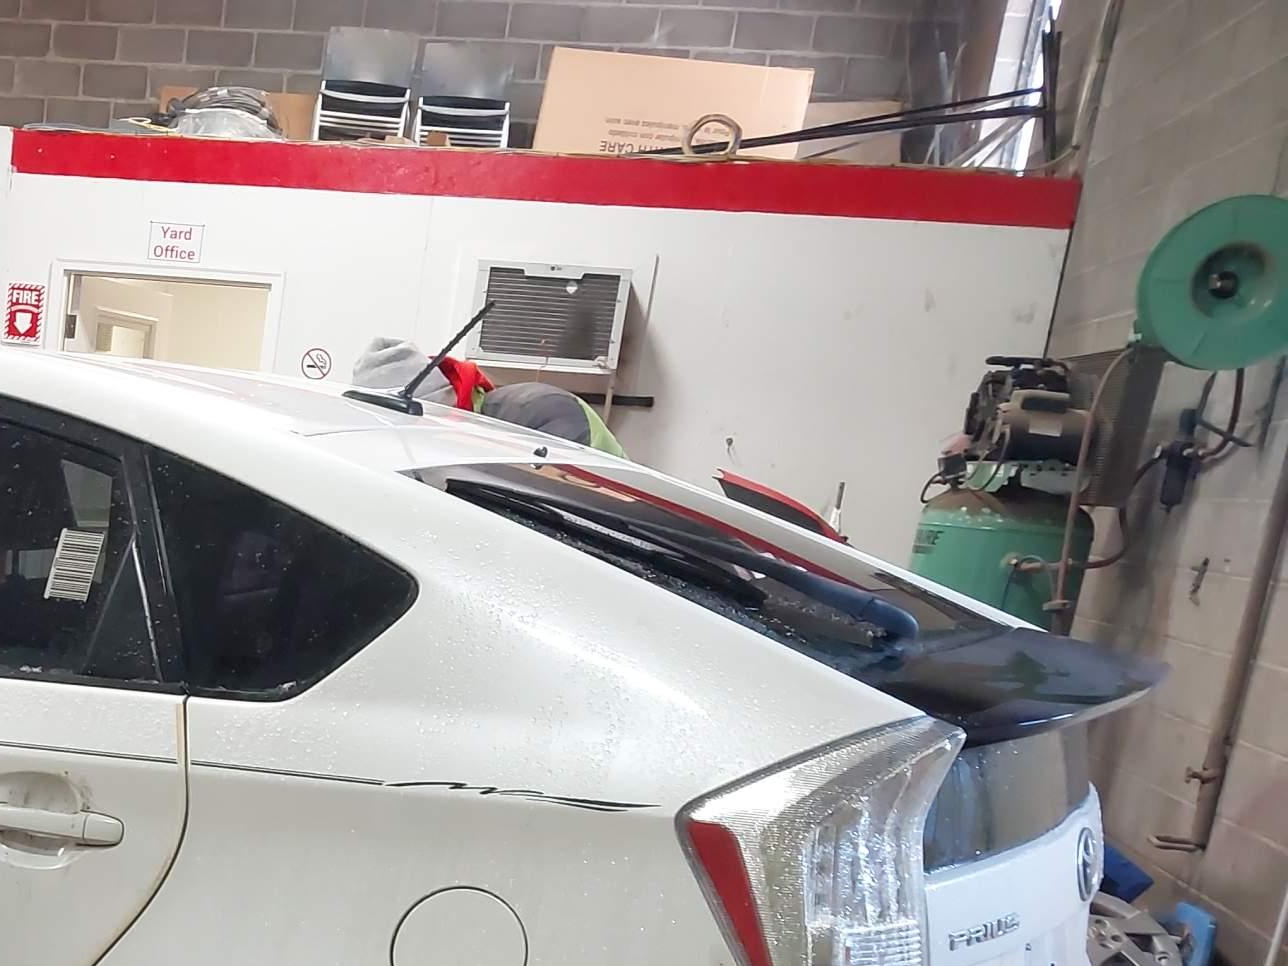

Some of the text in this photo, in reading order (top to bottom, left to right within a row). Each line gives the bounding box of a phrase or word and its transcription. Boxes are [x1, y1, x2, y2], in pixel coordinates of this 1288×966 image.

[161, 225, 193, 241] Yard
[153, 245, 196, 261] Office
[12, 289, 40, 305] FIRE
[949, 912, 1020, 951] PRIUS
